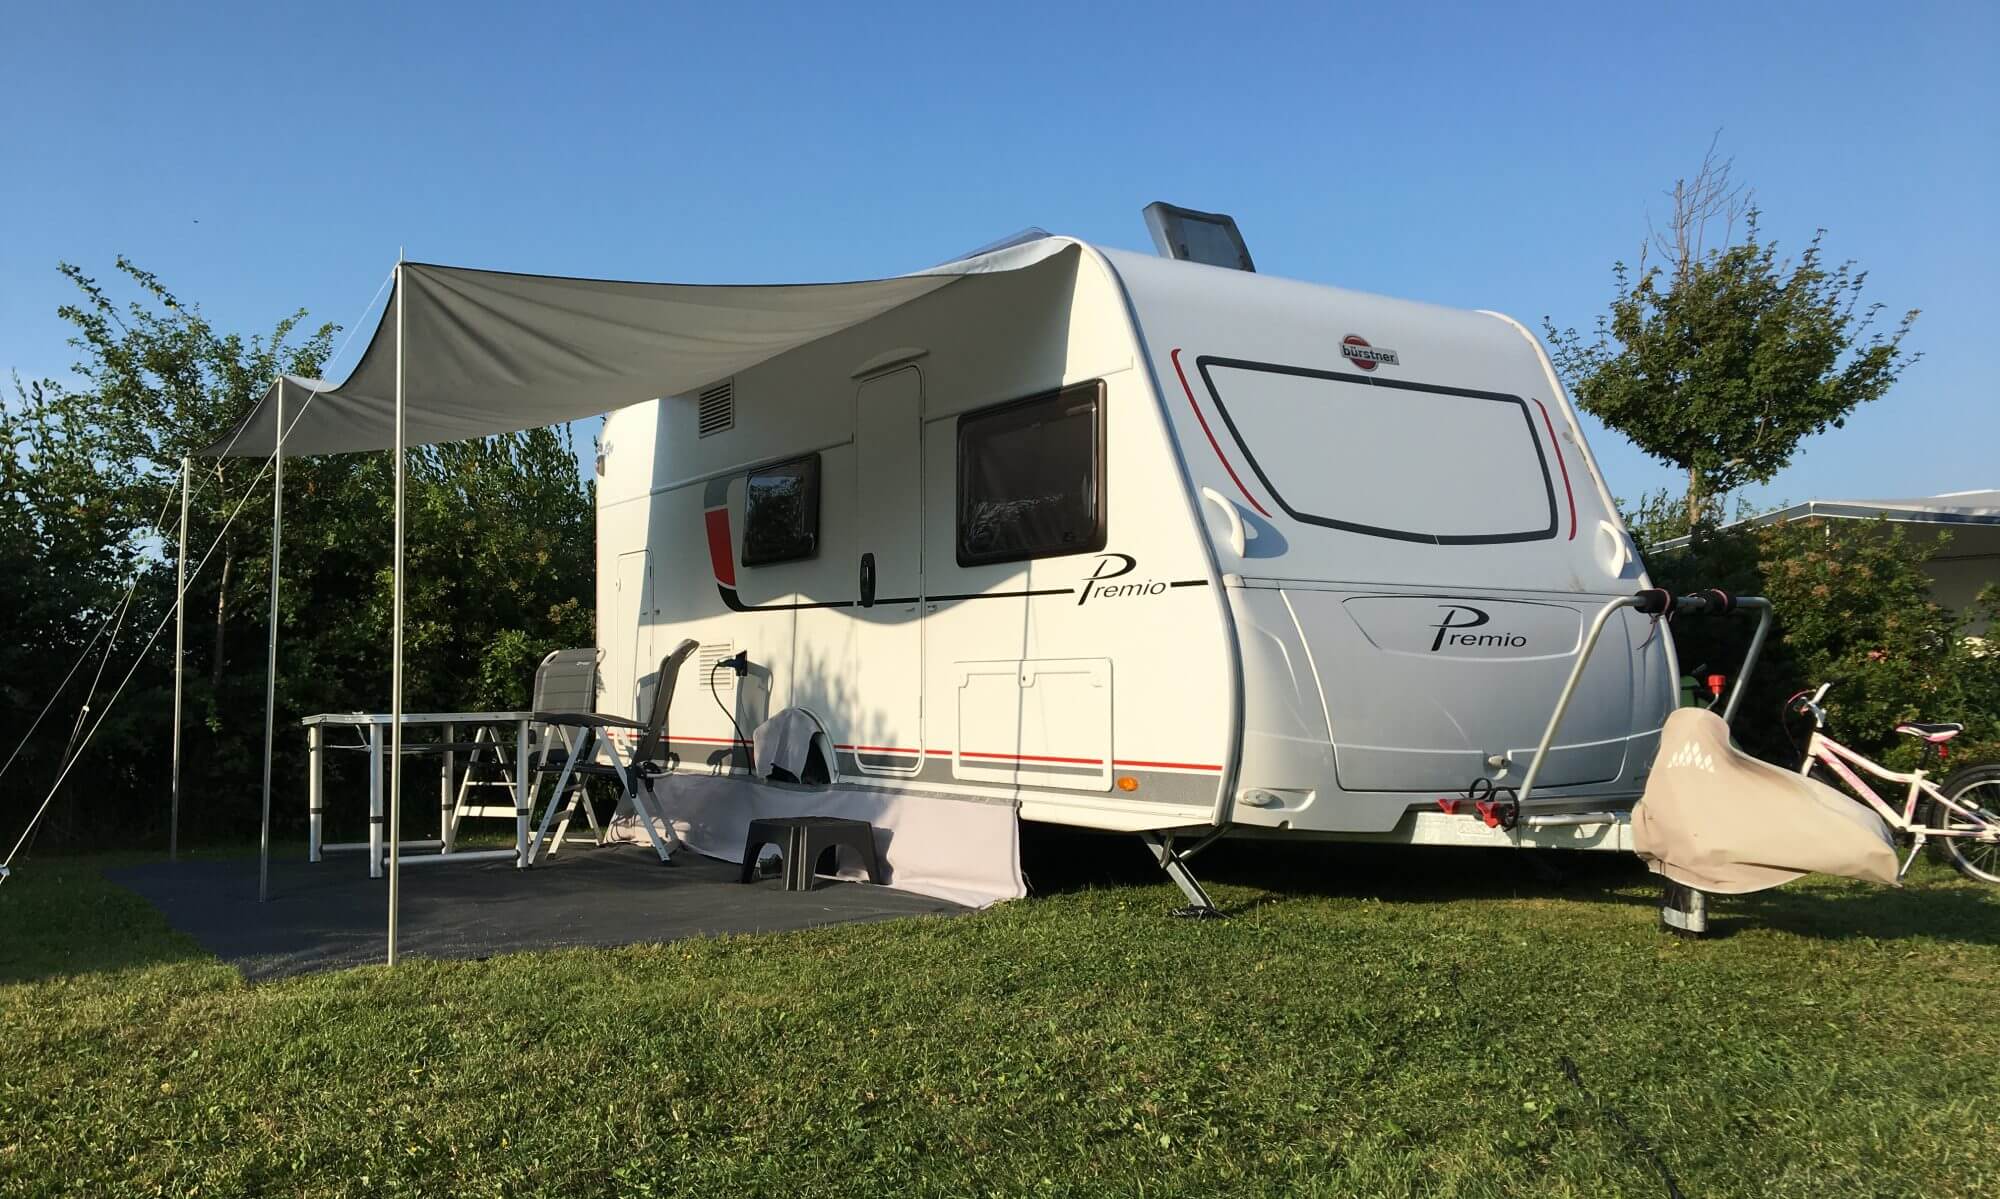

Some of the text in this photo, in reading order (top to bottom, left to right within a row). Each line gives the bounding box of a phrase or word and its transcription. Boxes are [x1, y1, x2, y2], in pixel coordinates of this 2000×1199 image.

[1342, 344, 1395, 363] bürstner
[1078, 553, 1166, 606] Premio
[1428, 604, 1527, 652] Premio
